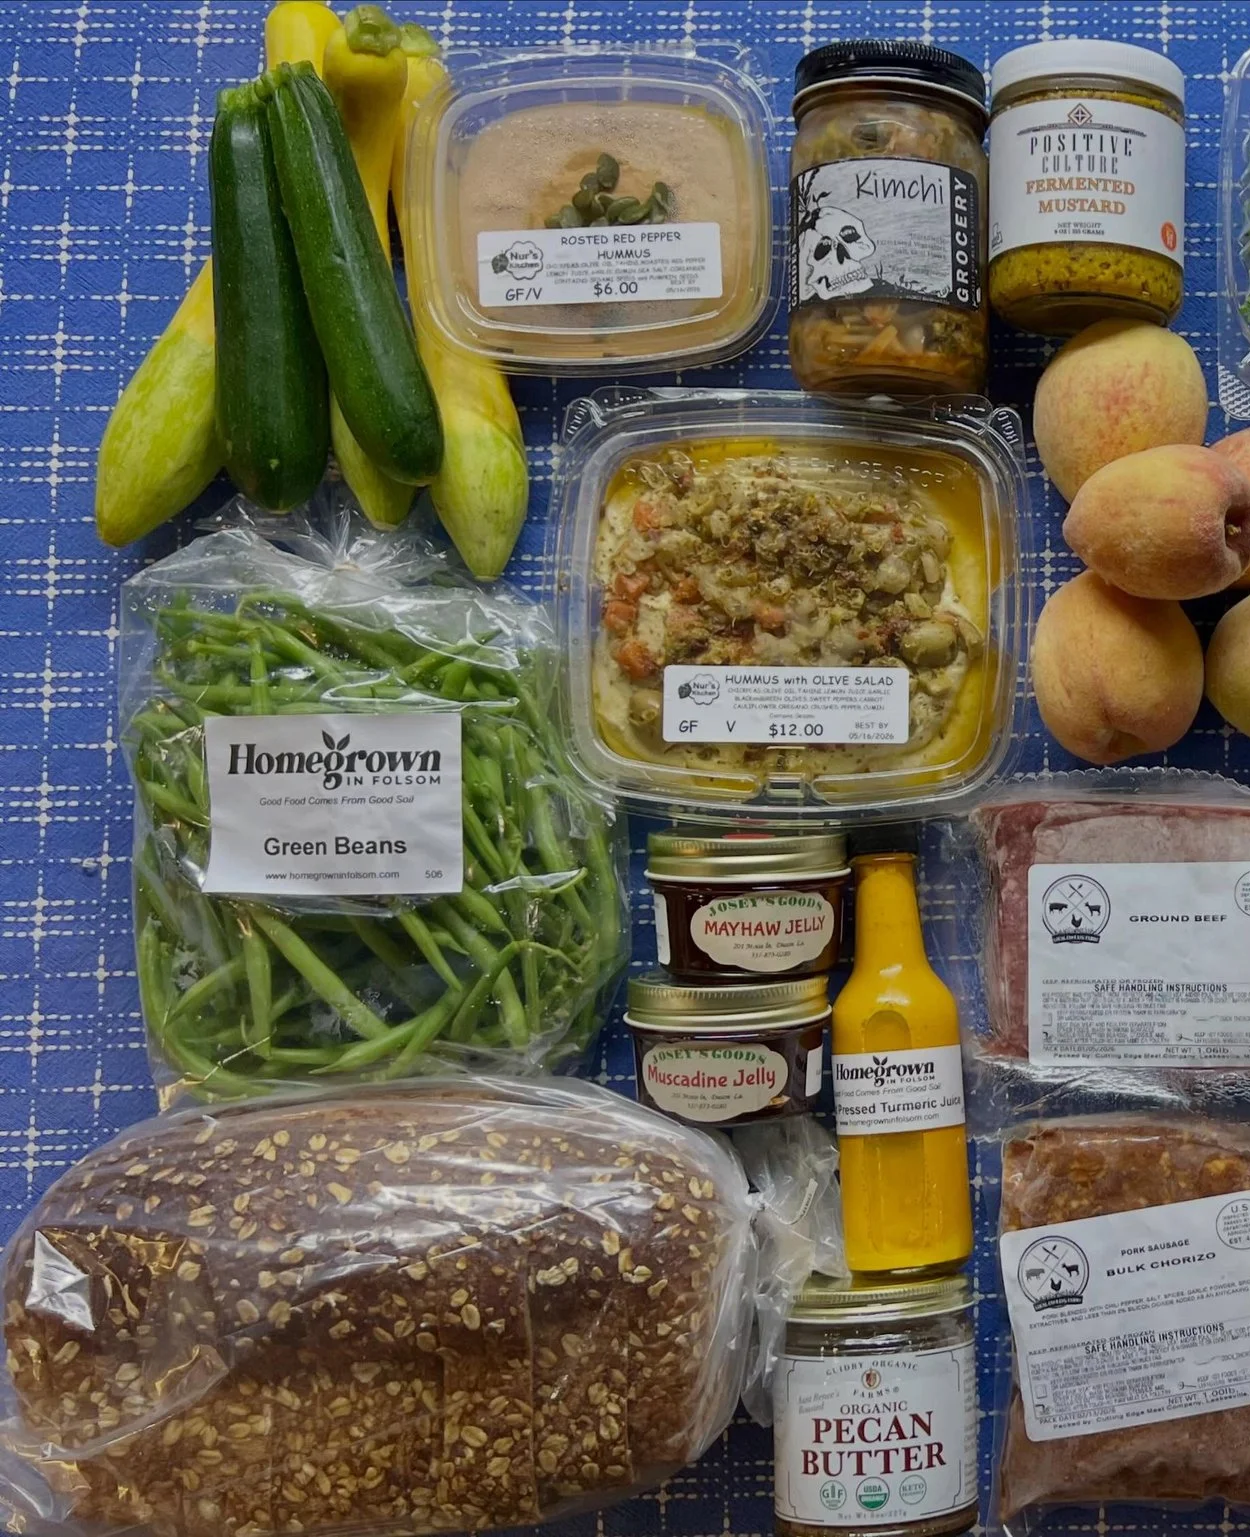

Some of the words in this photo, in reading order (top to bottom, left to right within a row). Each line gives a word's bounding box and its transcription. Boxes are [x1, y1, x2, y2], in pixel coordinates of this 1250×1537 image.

[1030, 133, 1132, 156] POSITIVE
[1042, 154, 1118, 174] CULTURE
[855, 171, 943, 204] Kimchi
[1026, 177, 1135, 195] FERMENTED
[1039, 198, 1126, 215] MUSTARD
[561, 234, 608, 246] ROSTED
[613, 234, 635, 244] RED
[640, 231, 681, 243] PEPPER
[954, 177, 969, 303] GROCERY
[510, 249, 539, 261] Nur's
[597, 249, 651, 260] HUMMUS
[505, 287, 542, 301] GF/V
[593, 281, 638, 297] $6.00
[692, 681, 716, 690] Nur's
[725, 674, 779, 685] HUMMUS
[784, 676, 807, 685] with
[813, 675, 851, 686] OLIVE
[854, 676, 894, 686] SALAD
[679, 720, 698, 733] GF
[726, 720, 736, 733] V
[769, 723, 823, 738] $12.00
[855, 721, 875, 730] BEST
[879, 721, 889, 730] BY
[227, 743, 441, 790] Homegrown
[346, 775, 363, 786] IN
[372, 775, 441, 786] FOLSOM
[260, 796, 282, 806] Good
[284, 796, 306, 805] Food
[308, 795, 338, 805] Comes
[341, 795, 366, 805] From
[368, 795, 393, 804] Good
[395, 795, 414, 804] Soil
[264, 837, 327, 856] Green
[335, 836, 408, 855] Beans
[425, 870, 443, 879] 506
[709, 896, 776, 917] JOSEY'S
[779, 896, 824, 911] GOODS
[704, 920, 781, 936] MAYHAW
[785, 915, 826, 935] JELLY
[1129, 914, 1189, 923] GROUND
[1194, 914, 1228, 922] BEEF
[1094, 984, 1116, 993] SAFE
[1119, 983, 1164, 992] HANDLING
[1166, 983, 1228, 993] INSTRUCTIONS
[652, 1049, 709, 1064] JOSEY'S
[712, 1050, 767, 1065] GOODS
[647, 1065, 728, 1088] Muscadine
[733, 1067, 776, 1089] Jelly
[836, 1061, 934, 1088] Homegrown
[900, 1075, 935, 1083] FOLSOM
[856, 1089, 880, 1097] Comes
[882, 1087, 903, 1095] From
[906, 1084, 927, 1093] Good
[838, 1103, 876, 1115] Pressed
[880, 1098, 937, 1113] Turmeric
[940, 1095, 961, 1107] Juice
[1121, 1247, 1146, 1256] PORK
[1148, 1238, 1190, 1252] SAUSAGE
[1106, 1262, 1146, 1277] BULK
[1150, 1252, 1216, 1269] CHORIZO
[1085, 1344, 1108, 1355] SAFE
[1110, 1335, 1156, 1352] HANDLING
[1158, 1322, 1225, 1343] INSTRUCTIONS
[826, 1361, 863, 1376] GUIDRY
[872, 1360, 918, 1371] ORGANIC
[840, 1400, 908, 1415] ORGANIC
[812, 1411, 933, 1444] PECAN
[801, 1442, 947, 1477] BUTTER
[863, 1485, 882, 1493] USDA
[902, 1483, 924, 1492] KETO
